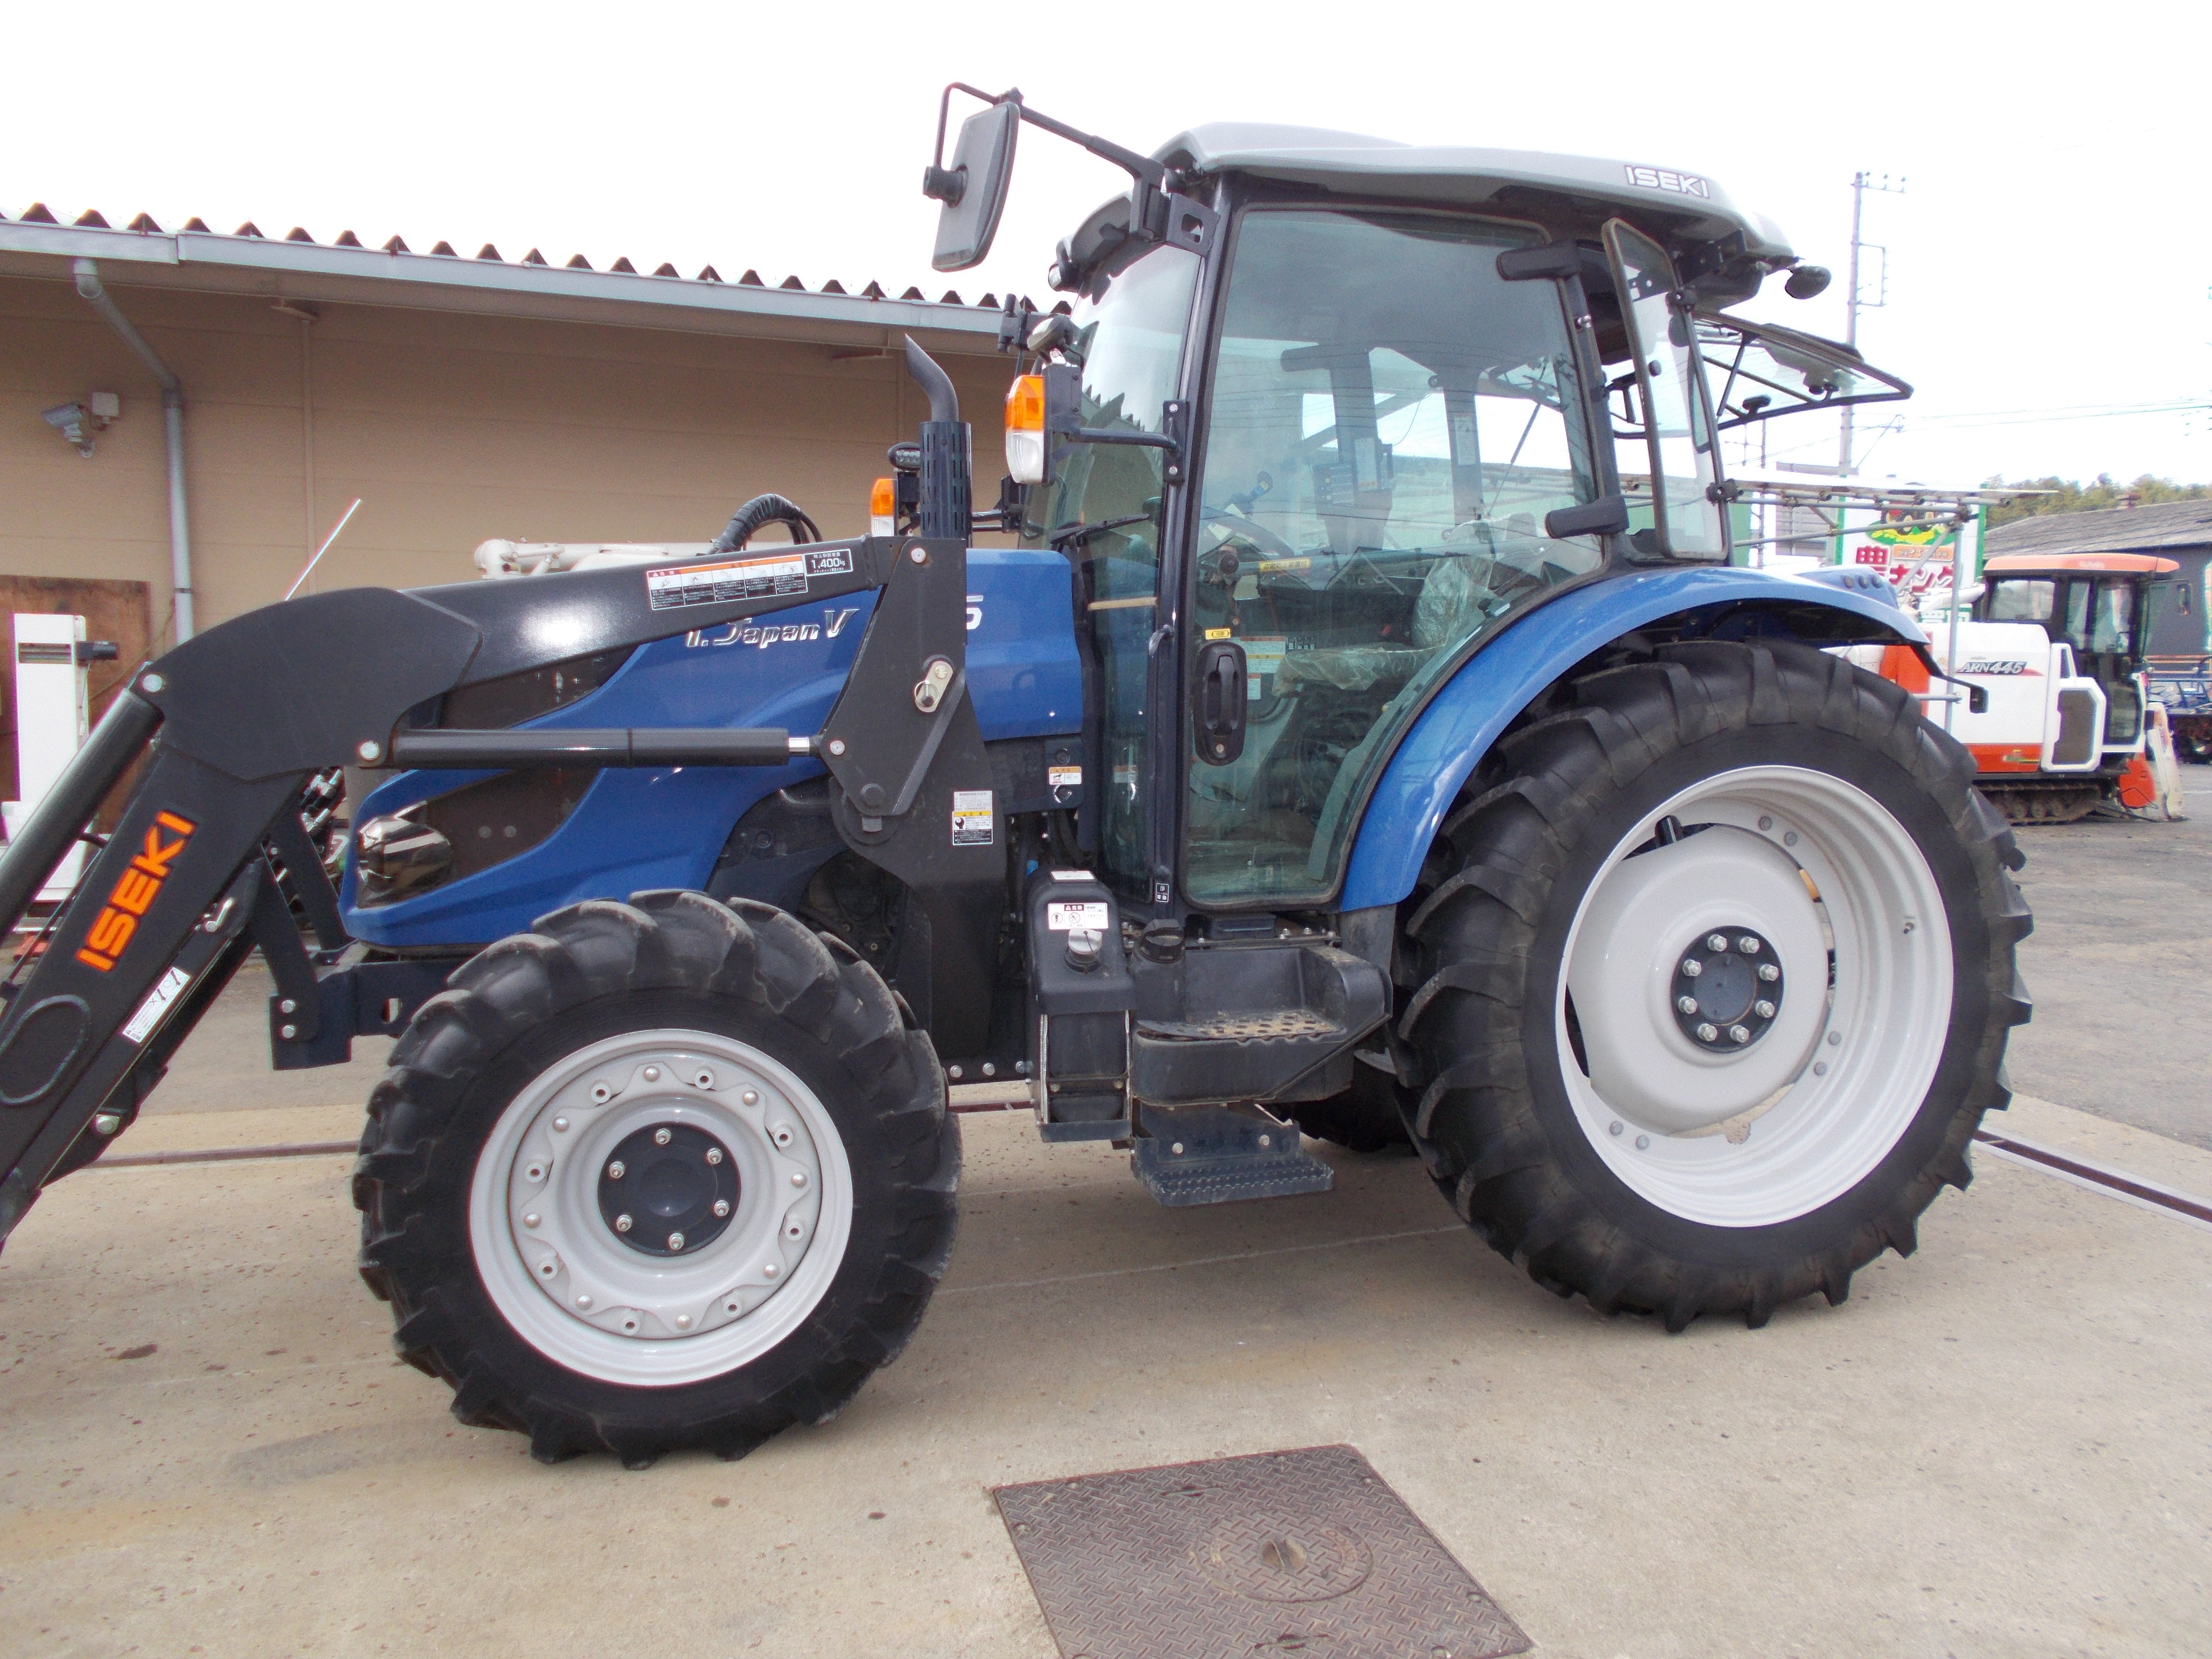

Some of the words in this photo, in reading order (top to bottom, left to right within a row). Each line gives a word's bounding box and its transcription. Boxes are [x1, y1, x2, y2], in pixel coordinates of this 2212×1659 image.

[1624, 165, 1709, 198] ISEKI
[811, 557, 845, 569] 1,400kg
[825, 608, 860, 638] V
[75, 809, 198, 972] ISEKI
